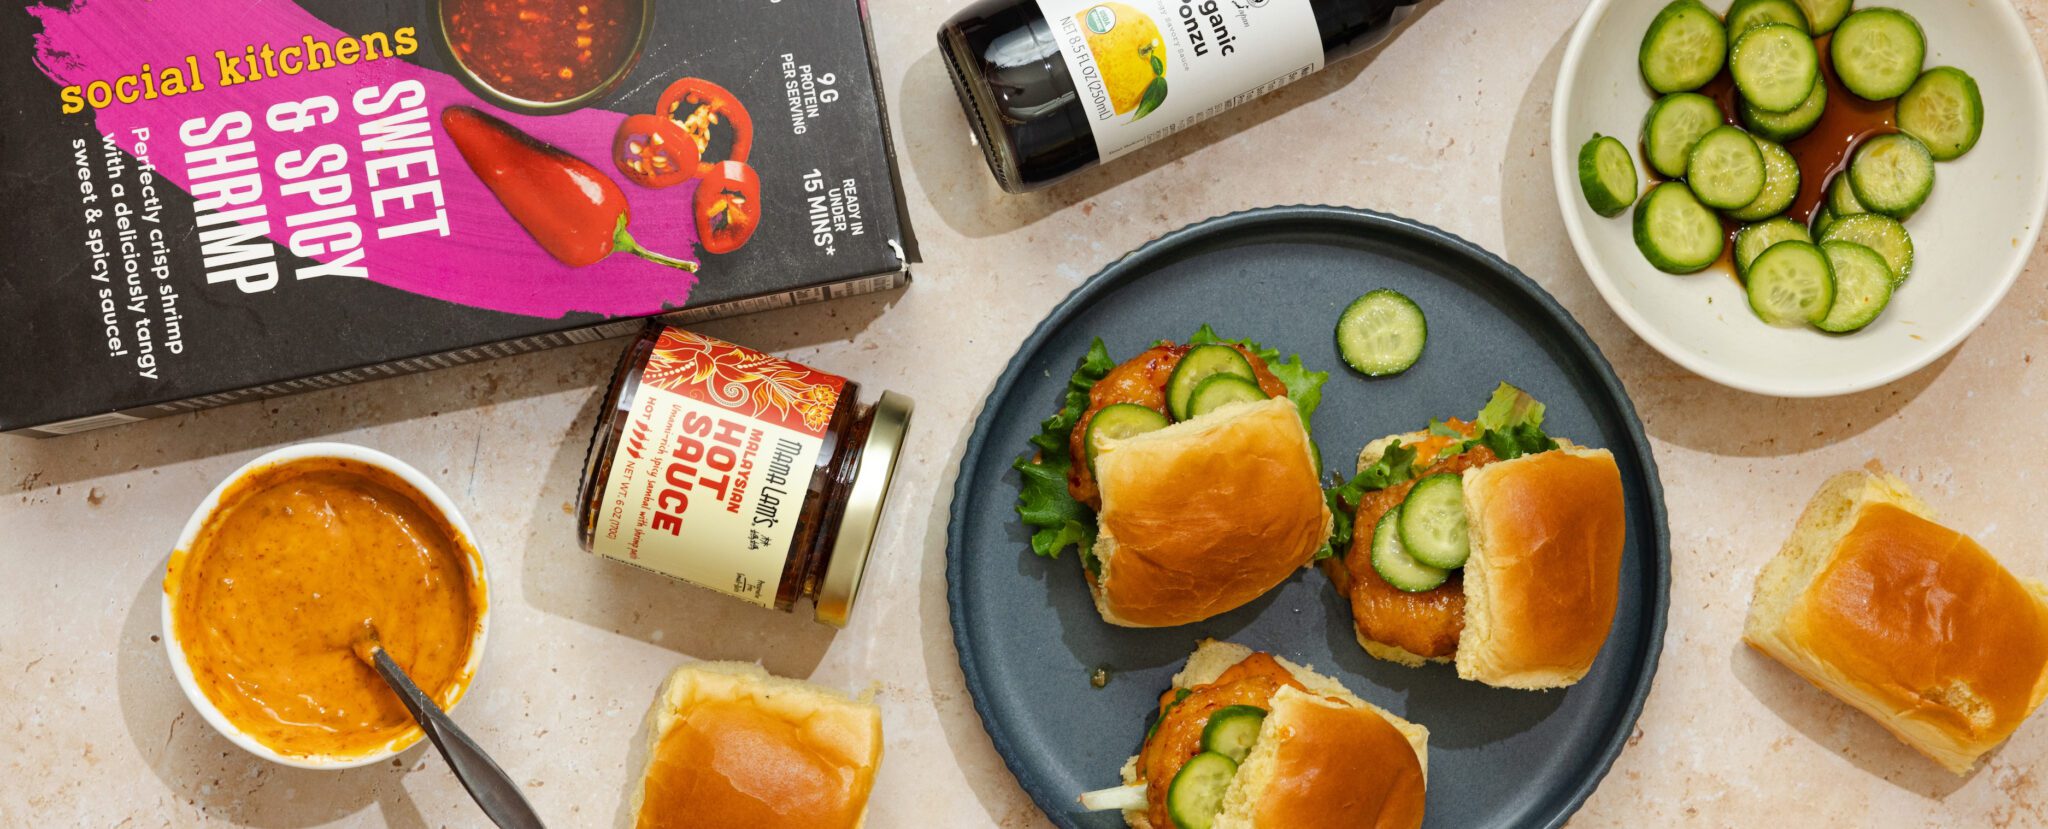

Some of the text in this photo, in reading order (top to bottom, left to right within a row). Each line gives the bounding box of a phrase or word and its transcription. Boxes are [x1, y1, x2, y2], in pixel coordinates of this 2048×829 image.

[1178, 0, 1209, 57] onzu
[1197, 0, 1236, 57] ganic
[60, 25, 419, 115] social kitchens
[816, 72, 839, 104] 9 G
[1060, 15, 1114, 121] NET 8.5 FL OZ (250mL)
[1178, 48, 1190, 72] Sauce
[265, 95, 340, 134] &
[781, 53, 807, 135] PER SERVING
[798, 64, 819, 118] PROTEIN
[352, 79, 451, 240] SWEET
[803, 168, 824, 193] 15
[179, 110, 280, 294] SHRIMP
[274, 143, 369, 281] SPICY
[828, 187, 847, 232] UNDER
[842, 178, 864, 236] READY IN
[72, 138, 128, 357] sweet & spicy sauce!
[102, 132, 159, 379] with a deliciously tangy
[131, 127, 183, 354] Perfectly crisp shrimp
[642, 396, 657, 420] HOT
[623, 460, 636, 481] NET
[646, 457, 663, 478] spicy
[650, 411, 713, 537] SAUCE
[698, 418, 747, 502] HOT
[726, 428, 764, 514] MALAYSIAN
[612, 506, 623, 519] OZ
[636, 511, 648, 527] with
[641, 479, 656, 511] sambal
